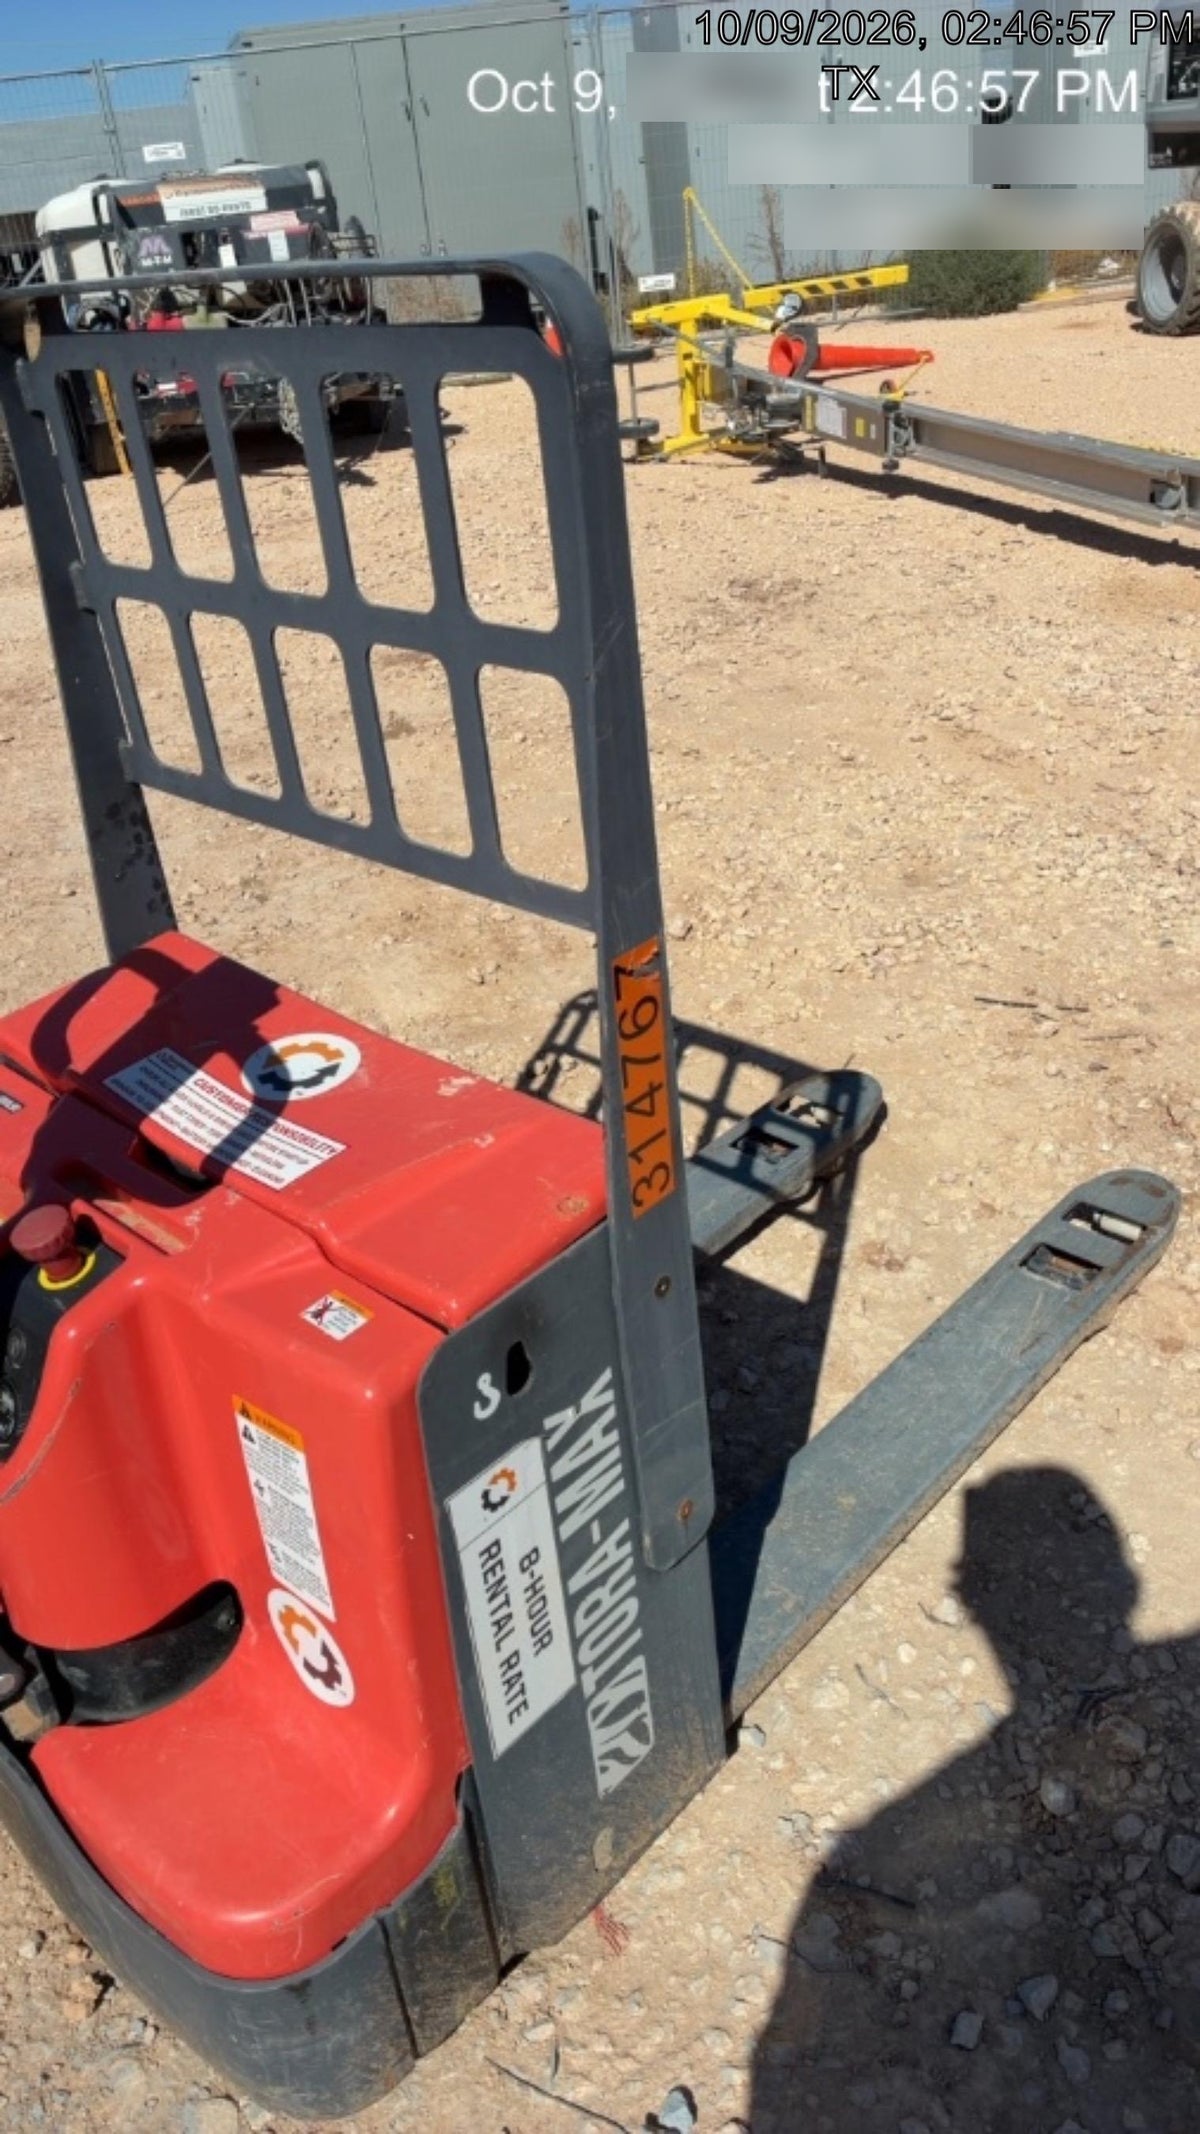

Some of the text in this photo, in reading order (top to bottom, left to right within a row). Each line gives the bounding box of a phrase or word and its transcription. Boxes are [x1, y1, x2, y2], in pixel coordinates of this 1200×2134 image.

[479, 1538, 530, 1726] RENTAL RATE
[518, 1545, 554, 1658] 8-HOUR
